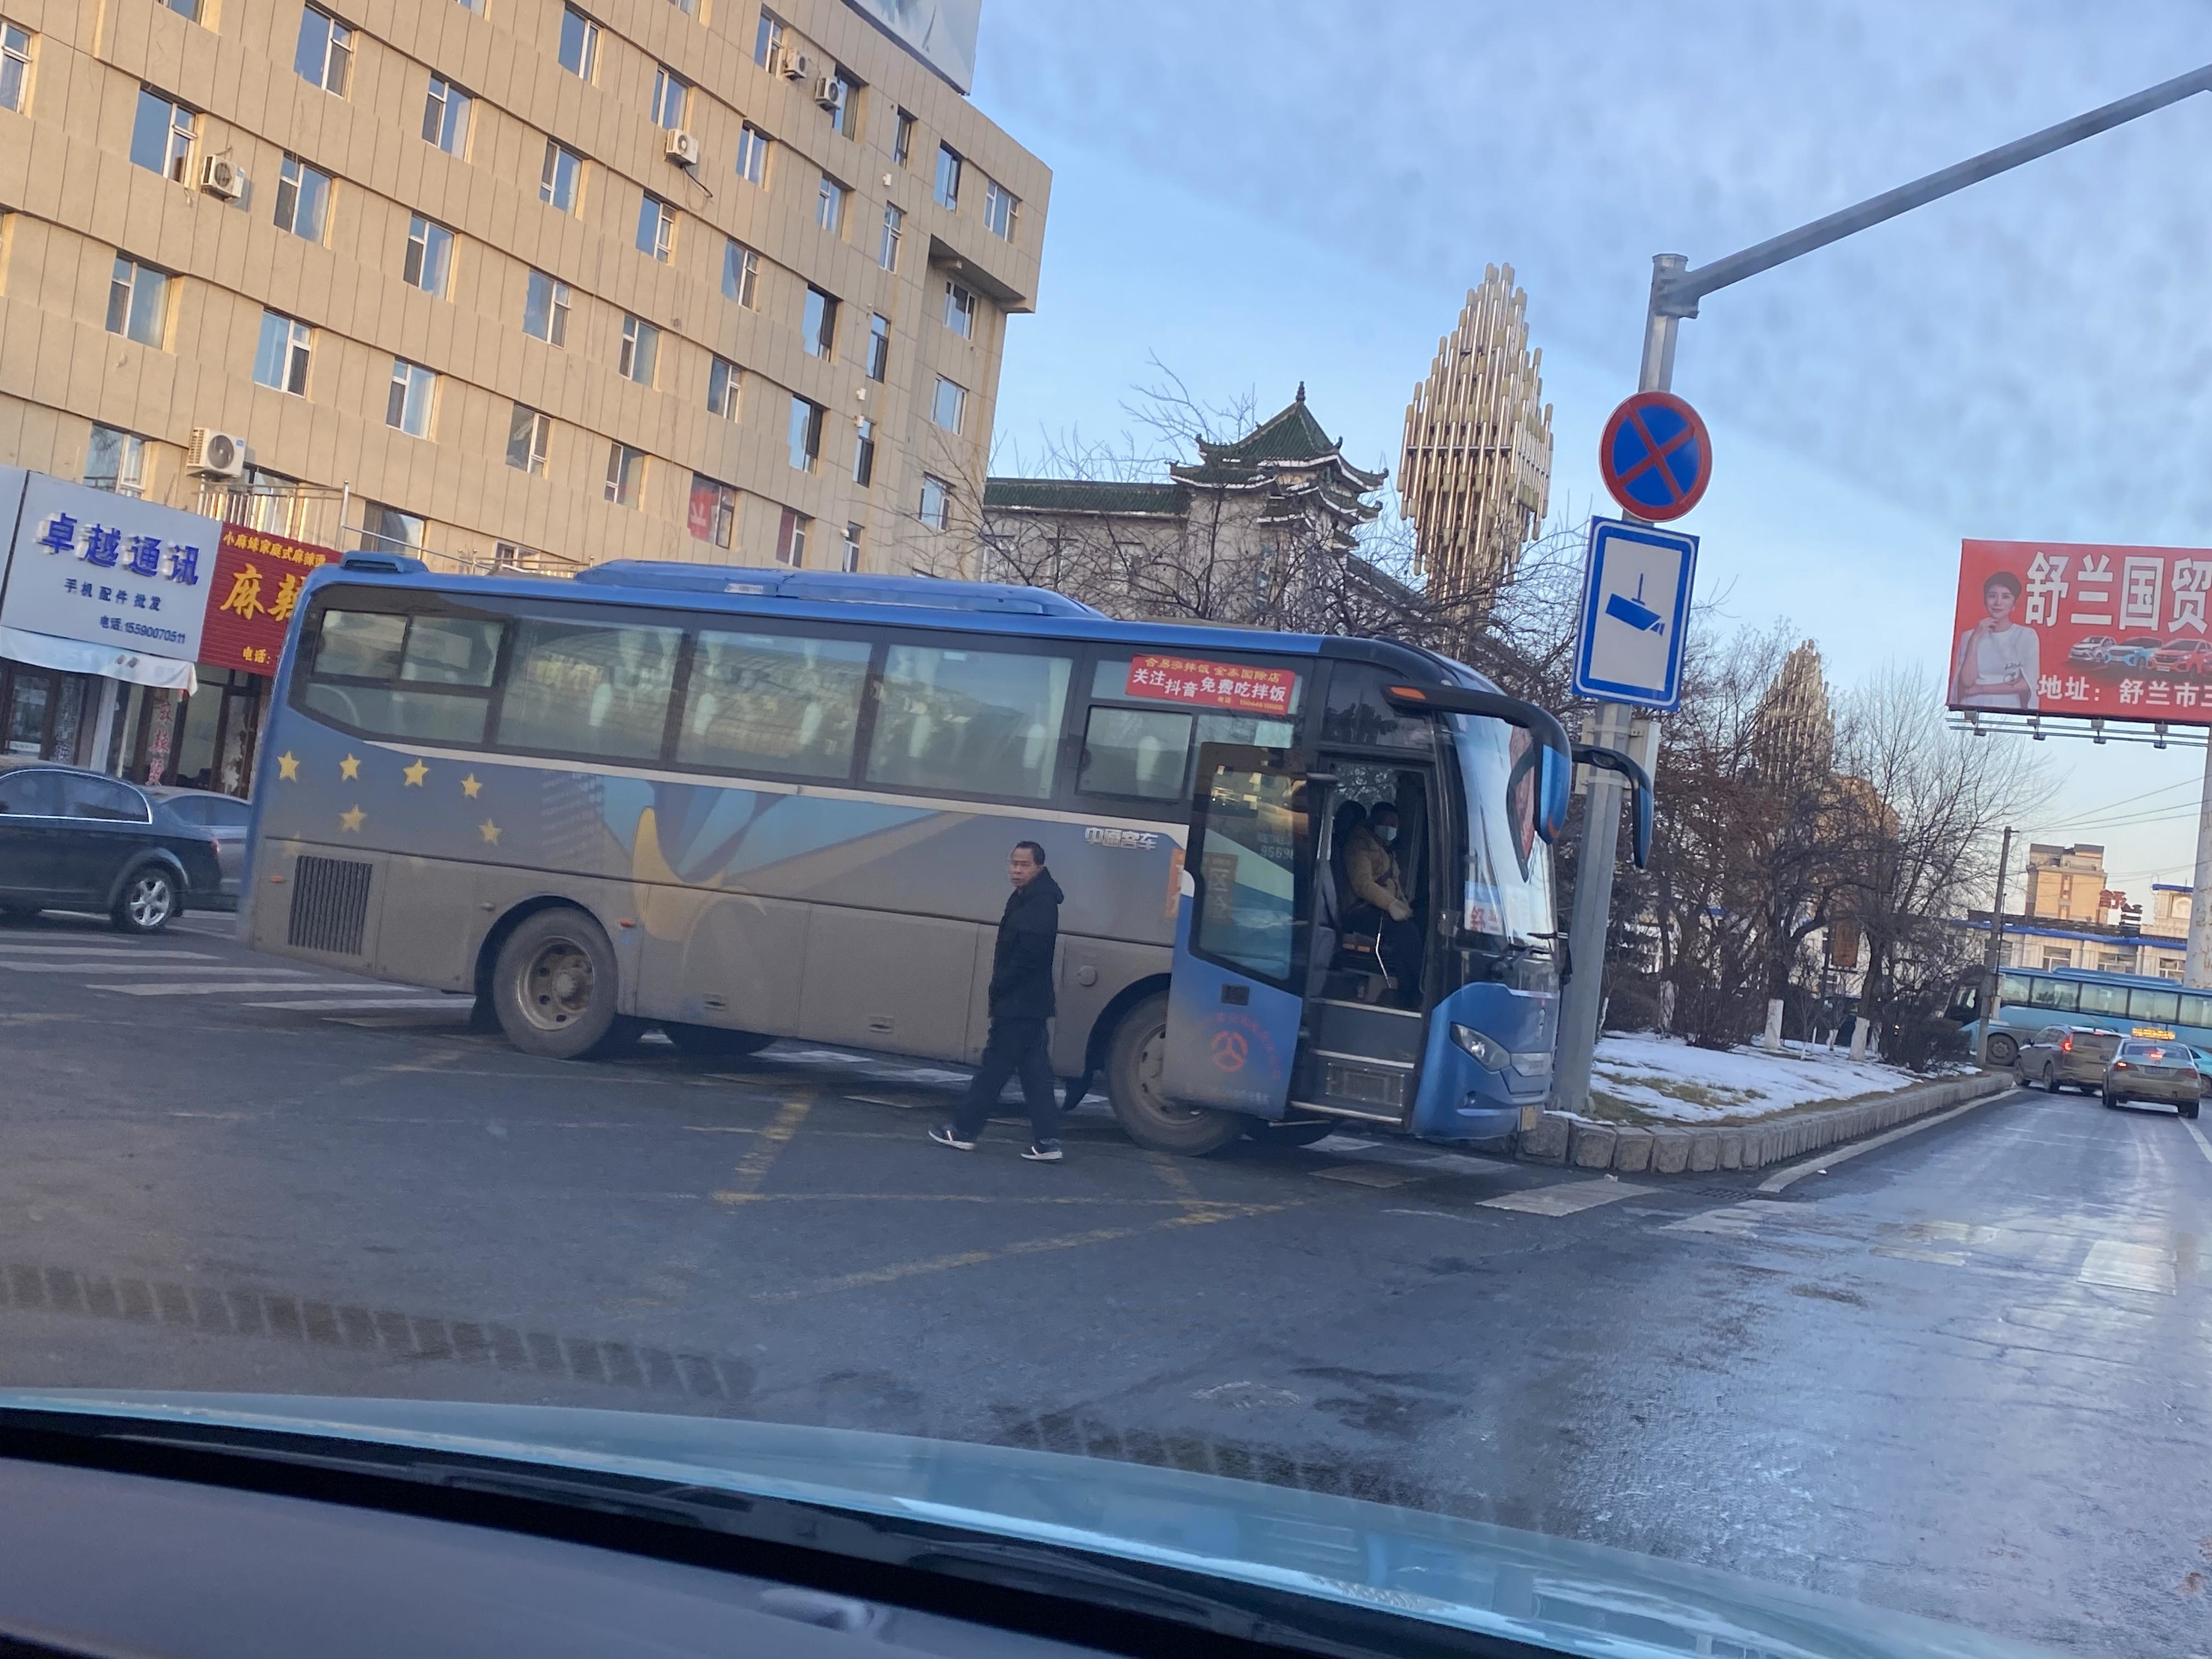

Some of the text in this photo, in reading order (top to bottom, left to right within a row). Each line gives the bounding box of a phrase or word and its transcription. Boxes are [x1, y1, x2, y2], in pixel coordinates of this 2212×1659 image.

[37, 513, 199, 585] 卓越通讯
[64, 578, 161, 611] 手机配件批发
[2025, 551, 2212, 634] 舒兰国贸
[1132, 668, 1286, 702] 关注抖音免费吃拌饭
